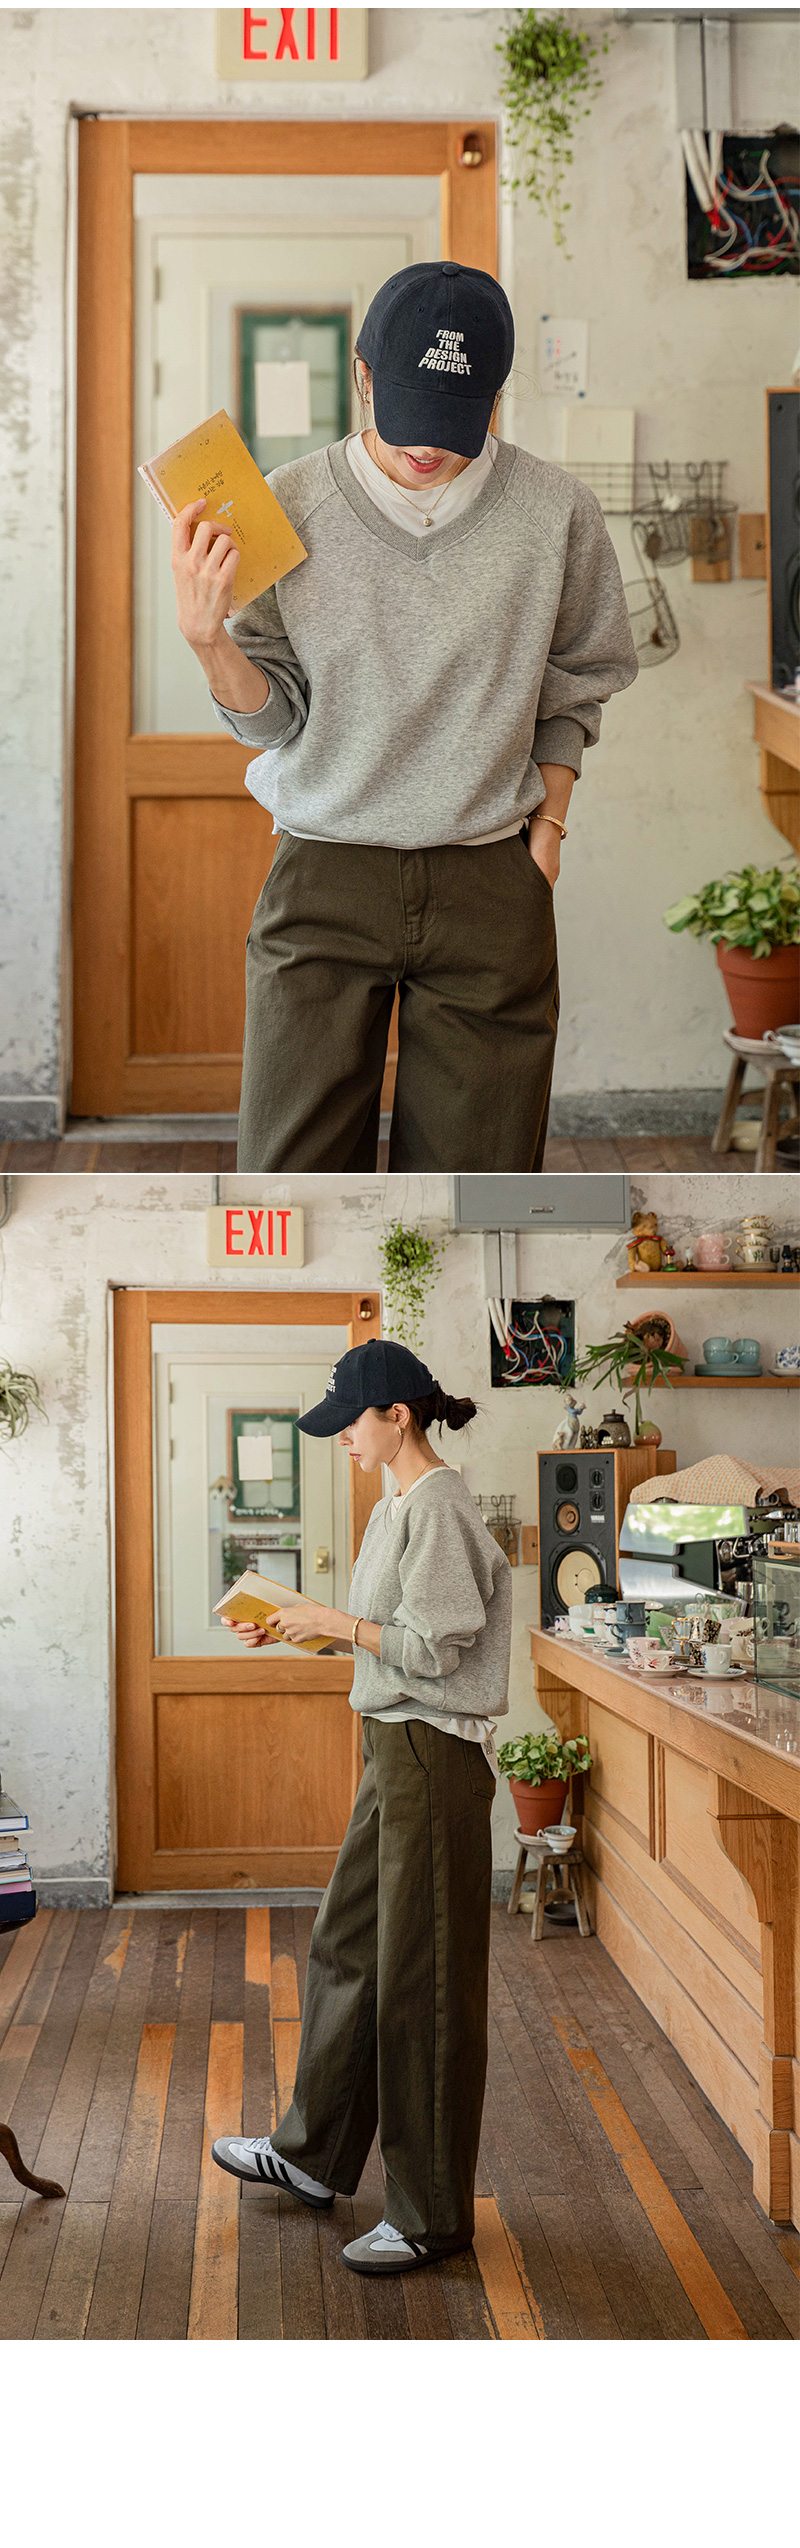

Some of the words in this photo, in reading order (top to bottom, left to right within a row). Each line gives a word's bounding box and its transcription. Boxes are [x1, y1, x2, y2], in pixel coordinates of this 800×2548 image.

[243, 8, 338, 60] EXIT
[436, 329, 464, 342] FROM
[438, 339, 460, 351] THE
[425, 347, 467, 363] DESIGN
[418, 357, 472, 375] PROJECT
[226, 1210, 291, 1256] EXIT
